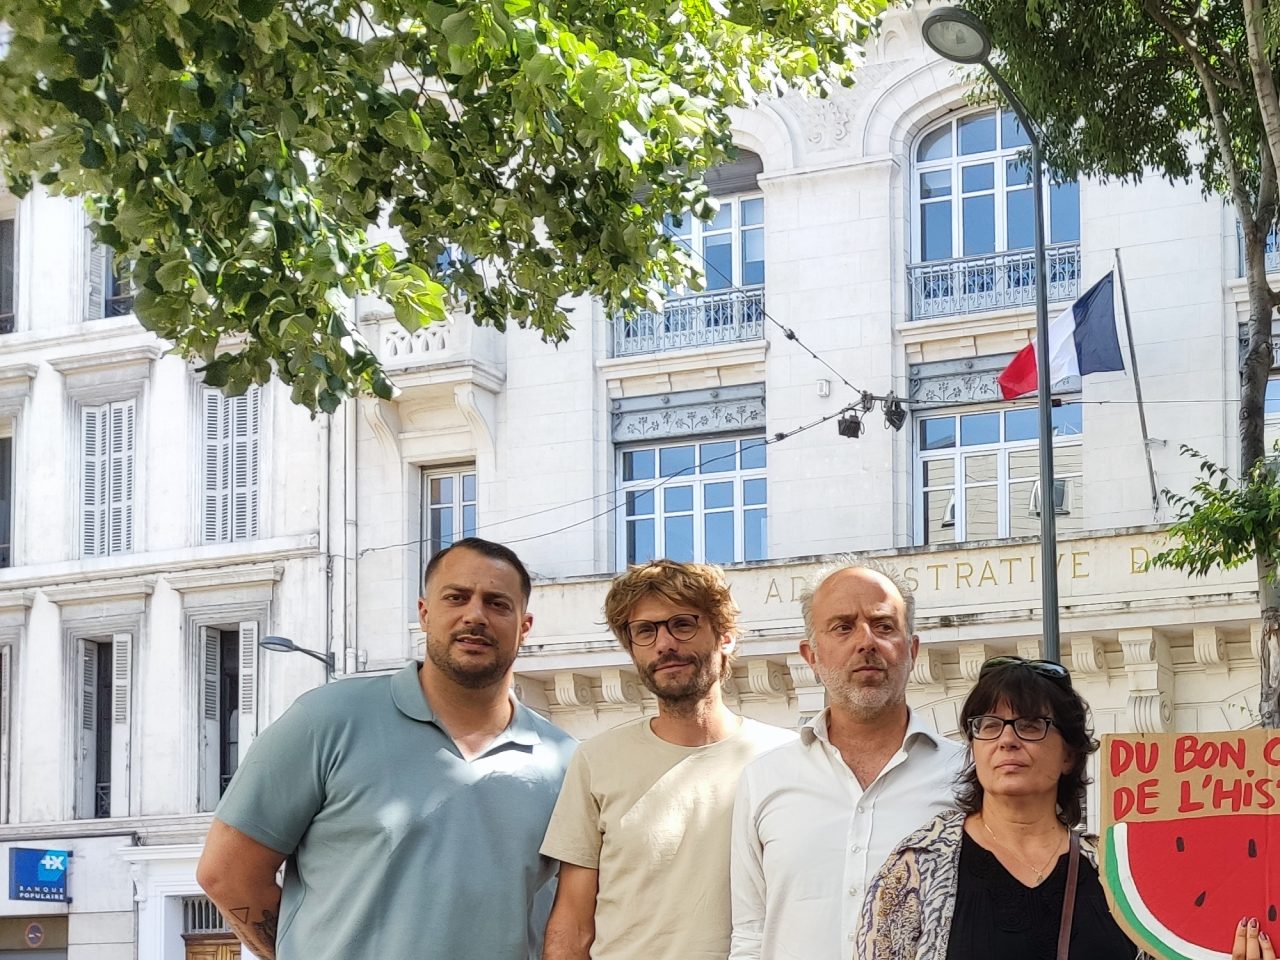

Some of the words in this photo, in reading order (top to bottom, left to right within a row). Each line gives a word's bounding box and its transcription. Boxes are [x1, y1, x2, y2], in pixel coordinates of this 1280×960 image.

[1110, 738, 1160, 777] DU
[1174, 735, 1246, 773] BON
[1113, 778, 1160, 821] DE
[19, 885, 64, 893] BANQUE
[19, 892, 64, 900] POPULAIRE
